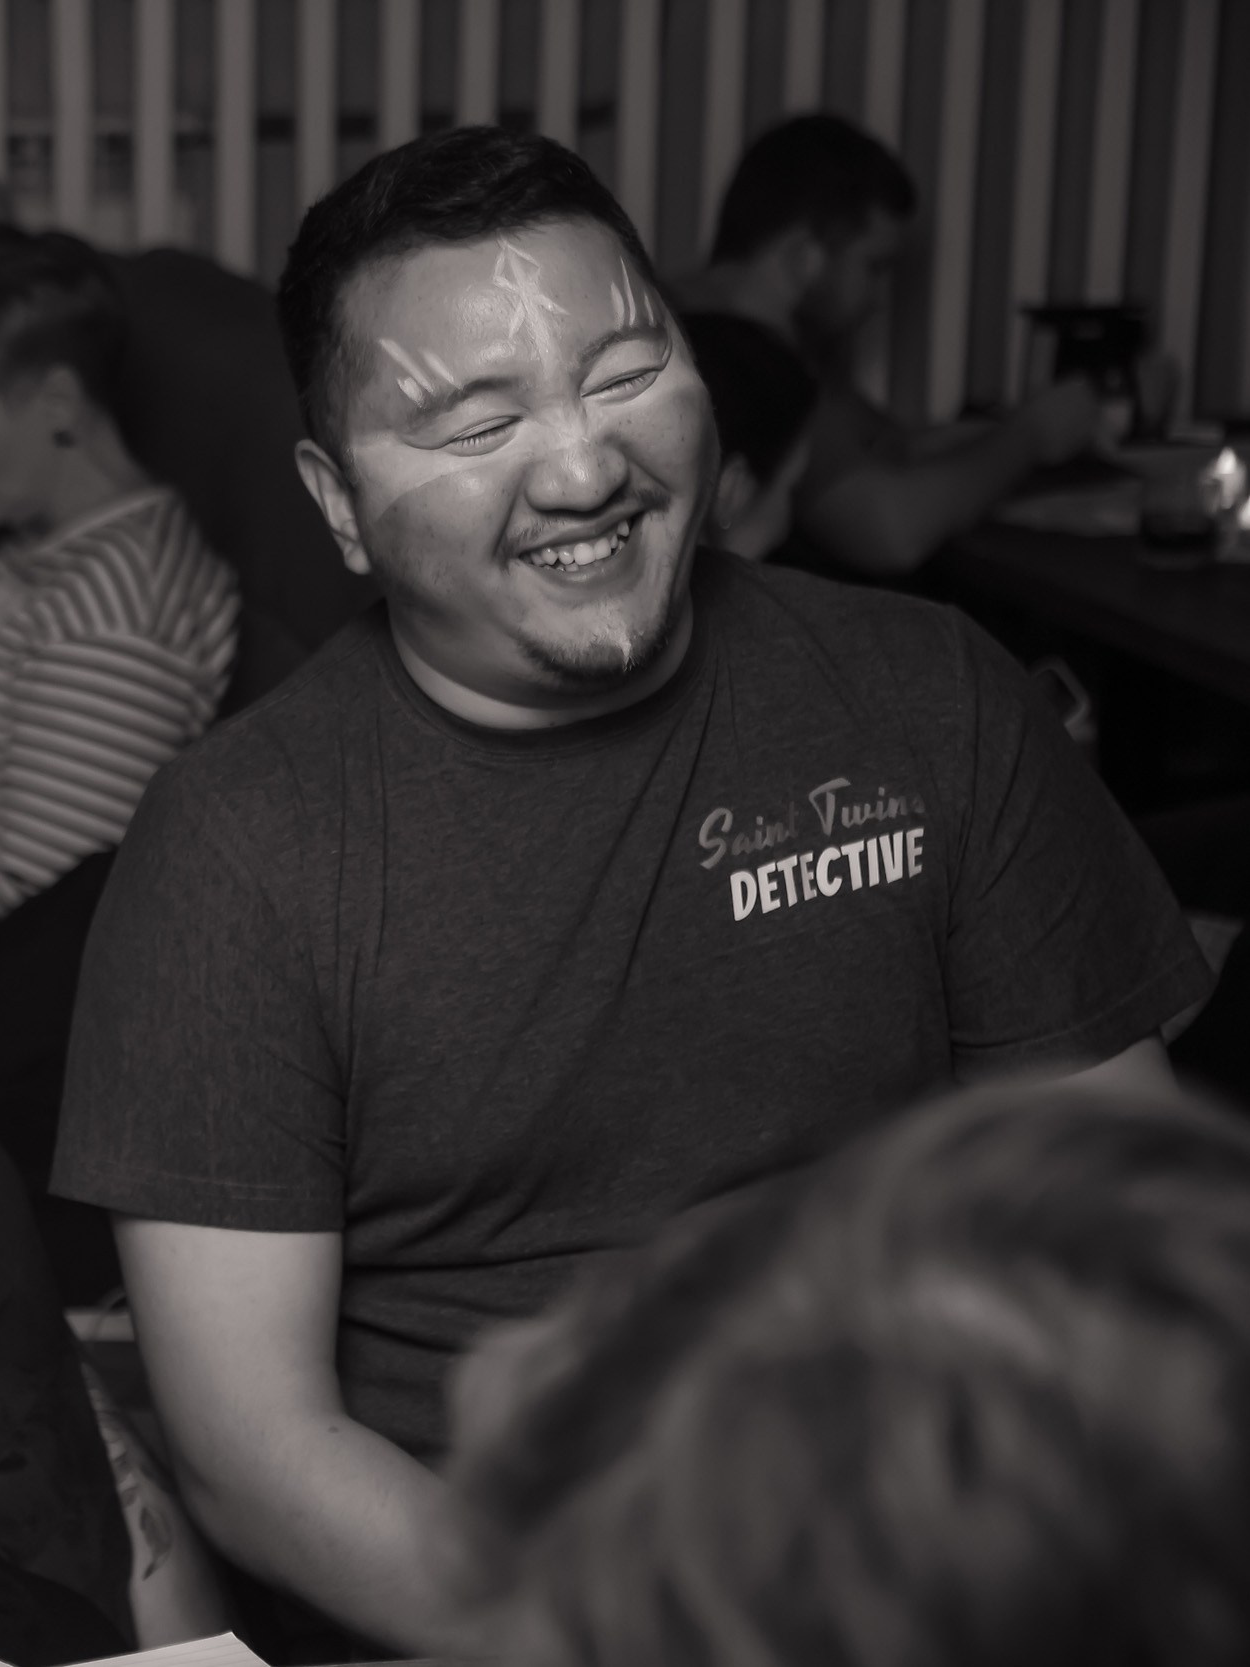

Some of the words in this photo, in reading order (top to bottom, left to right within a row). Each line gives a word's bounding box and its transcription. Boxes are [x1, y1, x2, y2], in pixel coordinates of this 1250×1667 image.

[699, 802, 798, 870] Saint
[809, 777, 926, 836] Twins
[730, 826, 925, 922] DETECTIVE
